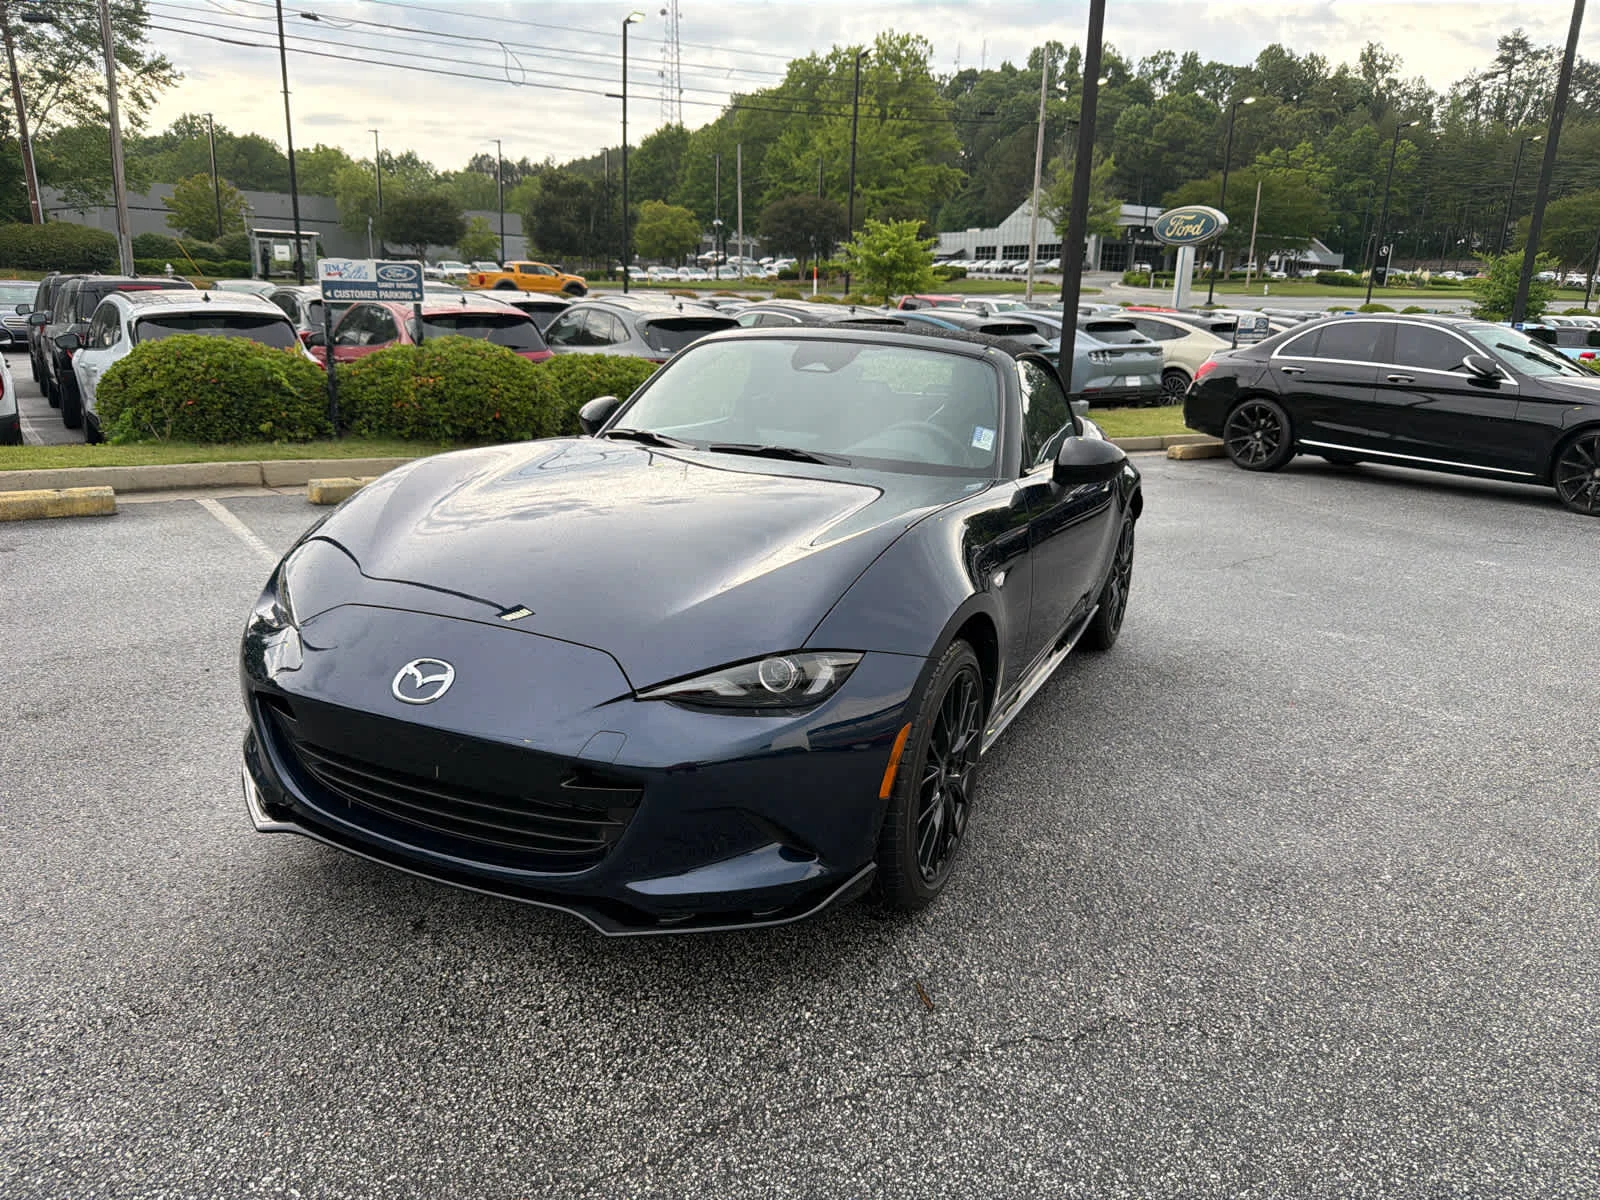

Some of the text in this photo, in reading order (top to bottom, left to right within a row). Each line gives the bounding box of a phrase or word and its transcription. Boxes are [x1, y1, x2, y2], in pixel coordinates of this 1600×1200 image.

[1165, 215, 1206, 237] Ford
[334, 289, 413, 299] CUSTOMER PARKING
